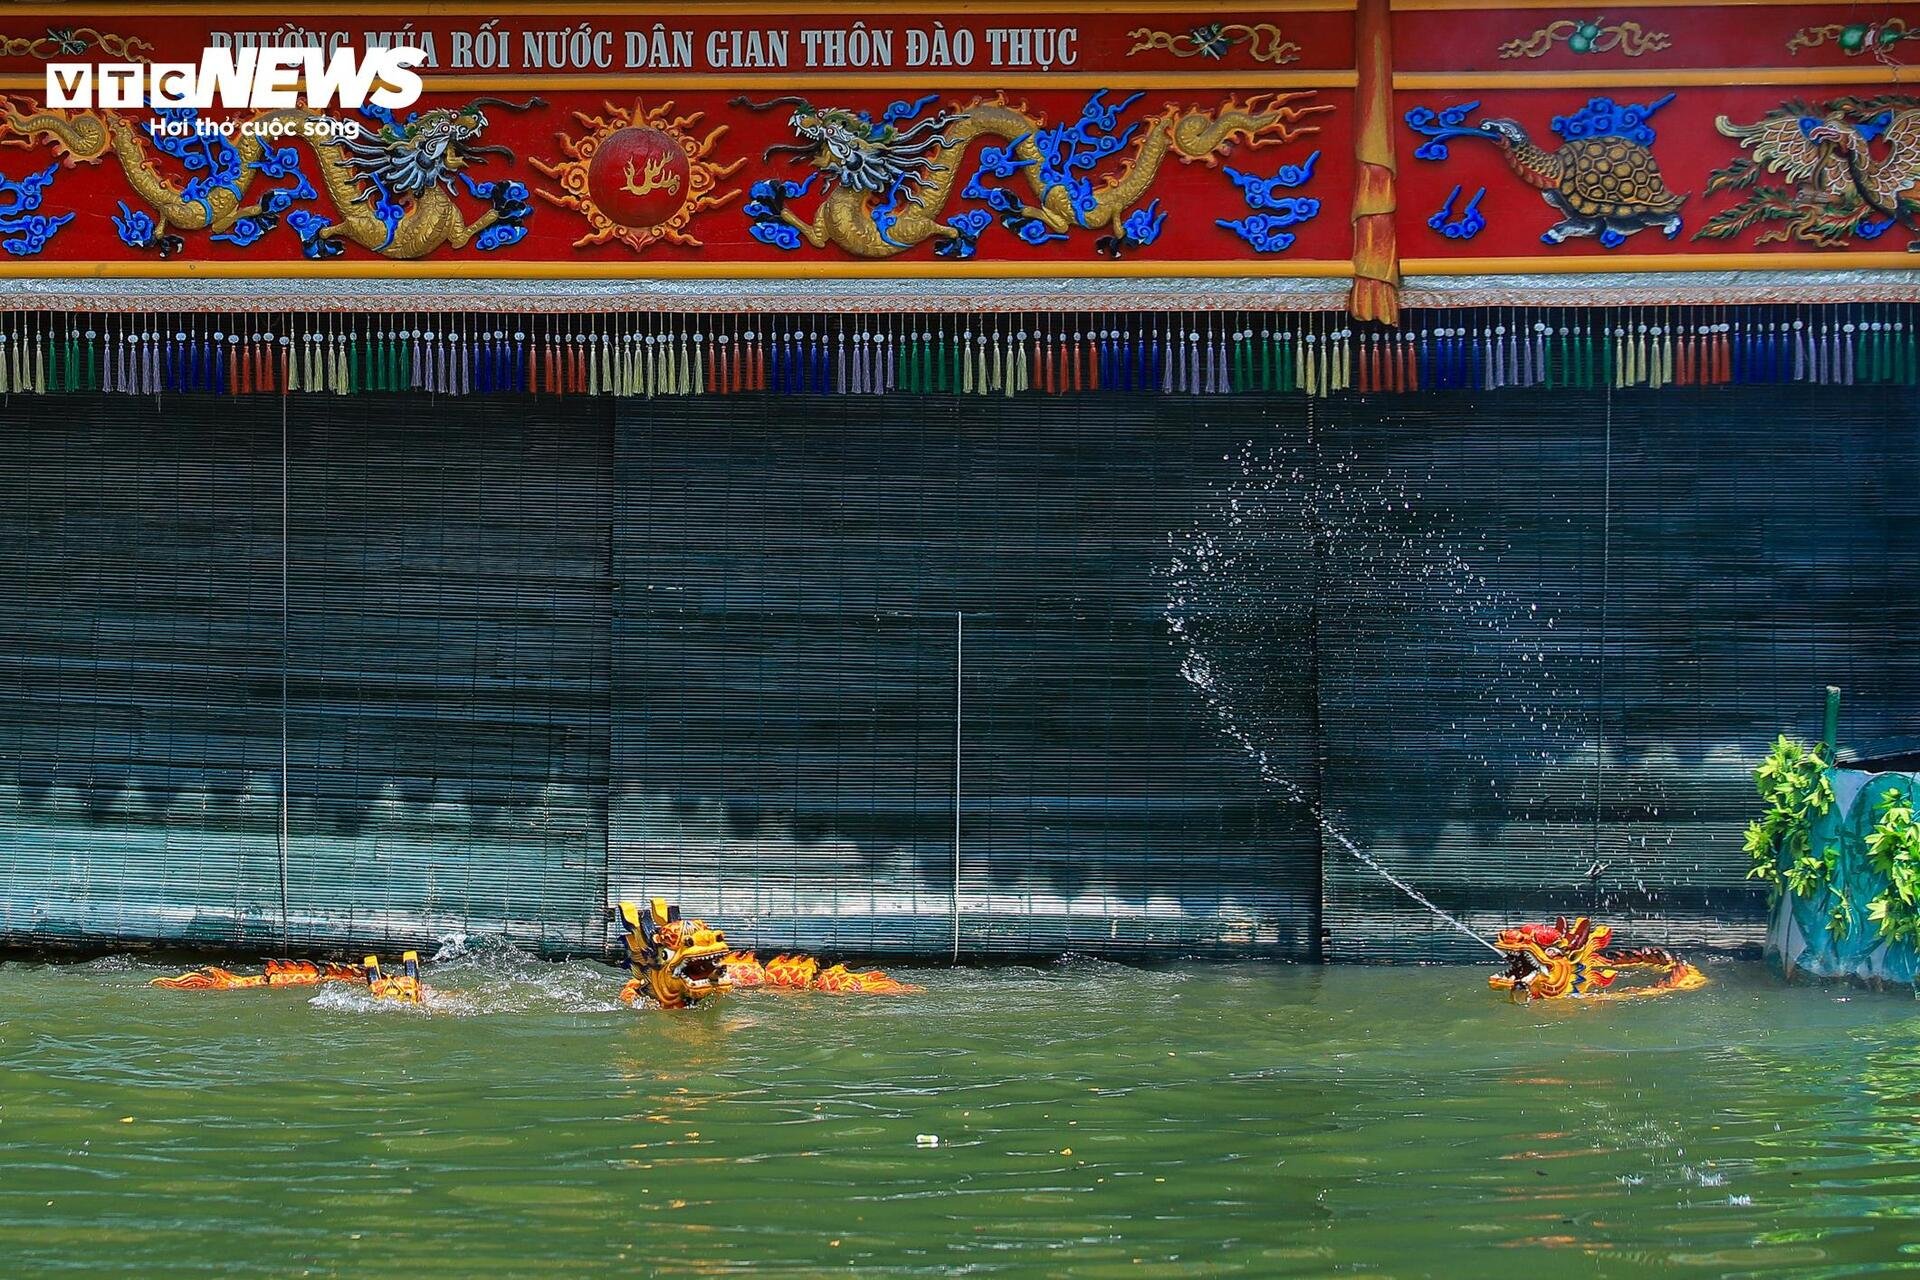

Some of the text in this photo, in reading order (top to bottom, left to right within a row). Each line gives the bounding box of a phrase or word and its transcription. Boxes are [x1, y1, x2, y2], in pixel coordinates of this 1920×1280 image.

[451, 19, 510, 68] RỐI
[522, 22, 612, 68] NƯỚC
[625, 23, 693, 68] DÂN
[706, 30, 789, 67] GIAN
[801, 21, 893, 67] THÔN
[906, 21, 974, 66] ĐÀO
[986, 28, 1077, 71] THỤC
